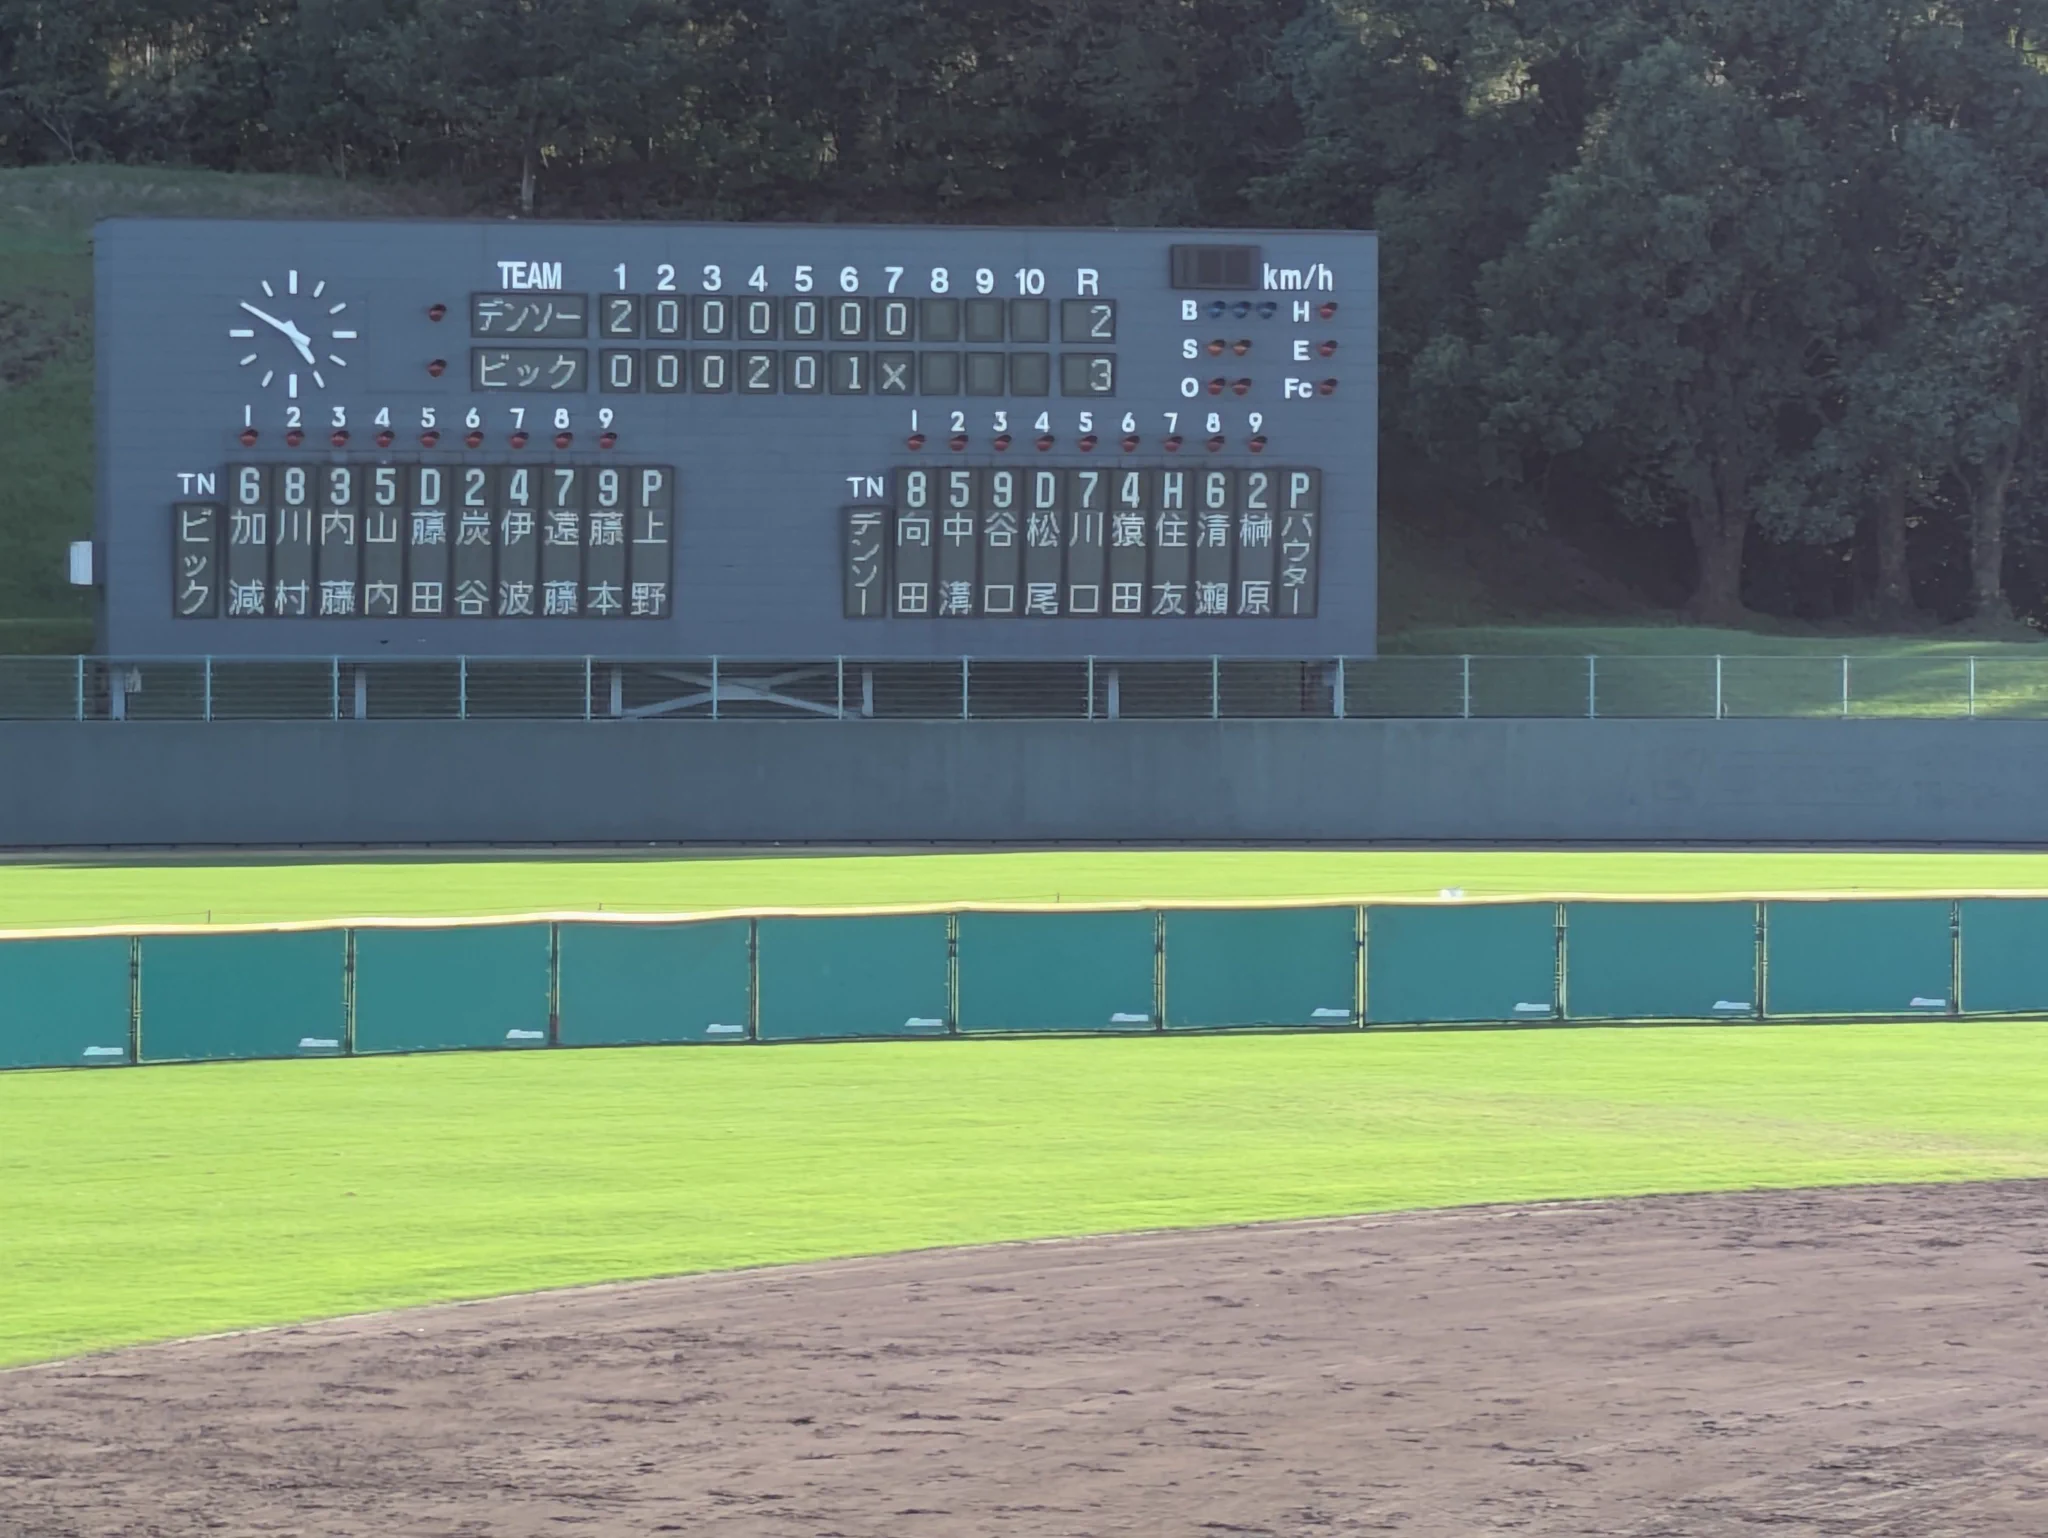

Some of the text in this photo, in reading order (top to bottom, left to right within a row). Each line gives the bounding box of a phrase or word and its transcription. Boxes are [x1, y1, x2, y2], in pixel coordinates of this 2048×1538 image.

[478, 298, 1112, 338] デンソー 2 0 0 0 0 0 0 2
[496, 260, 1099, 296] TEAM 1 2 3 4 5 6 7 8 9 10 R
[1181, 299, 1310, 323] B H
[1263, 262, 1333, 292] km/h
[480, 354, 576, 389] ビック
[610, 356, 632, 387] 0
[657, 356, 678, 388] 0
[703, 356, 725, 388] 0
[748, 356, 770, 389] 2
[794, 356, 816, 389] 0
[848, 356, 862, 390] 1
[1090, 361, 1112, 391] 3
[1180, 377, 1313, 399] O Fc
[1182, 338, 1311, 361] S E
[245, 404, 614, 429] 1 2 3 4 5 6 7 8 9
[911, 409, 1263, 434] 1 2 3 4 5 6 7 8 9
[176, 468, 663, 507] TN 6 8 3 5 D 2 4 7 9 P
[846, 470, 1310, 509] TN 8 5 9 D 7 4 H 6 2 P
[181, 509, 212, 615] ビック
[274, 508, 312, 615] 川村
[319, 509, 355, 615] 内藤
[364, 511, 398, 615] 山内
[411, 509, 446, 613] 藤田
[454, 509, 491, 615] 炭谷
[498, 509, 536, 615] 伊波
[542, 510, 580, 616] 遠藤
[587, 511, 624, 615] 藤本
[630, 510, 668, 615] 上野
[850, 512, 881, 616] デンソー
[897, 511, 930, 613] 向田
[939, 511, 973, 615] 中溝
[983, 511, 1018, 613] 谷口
[1025, 511, 1061, 615] 松尾
[1069, 511, 1104, 613] 川口
[1111, 512, 1146, 613] 猿田
[1152, 511, 1189, 615] 住友
[1237, 512, 1273, 615] 榊原
